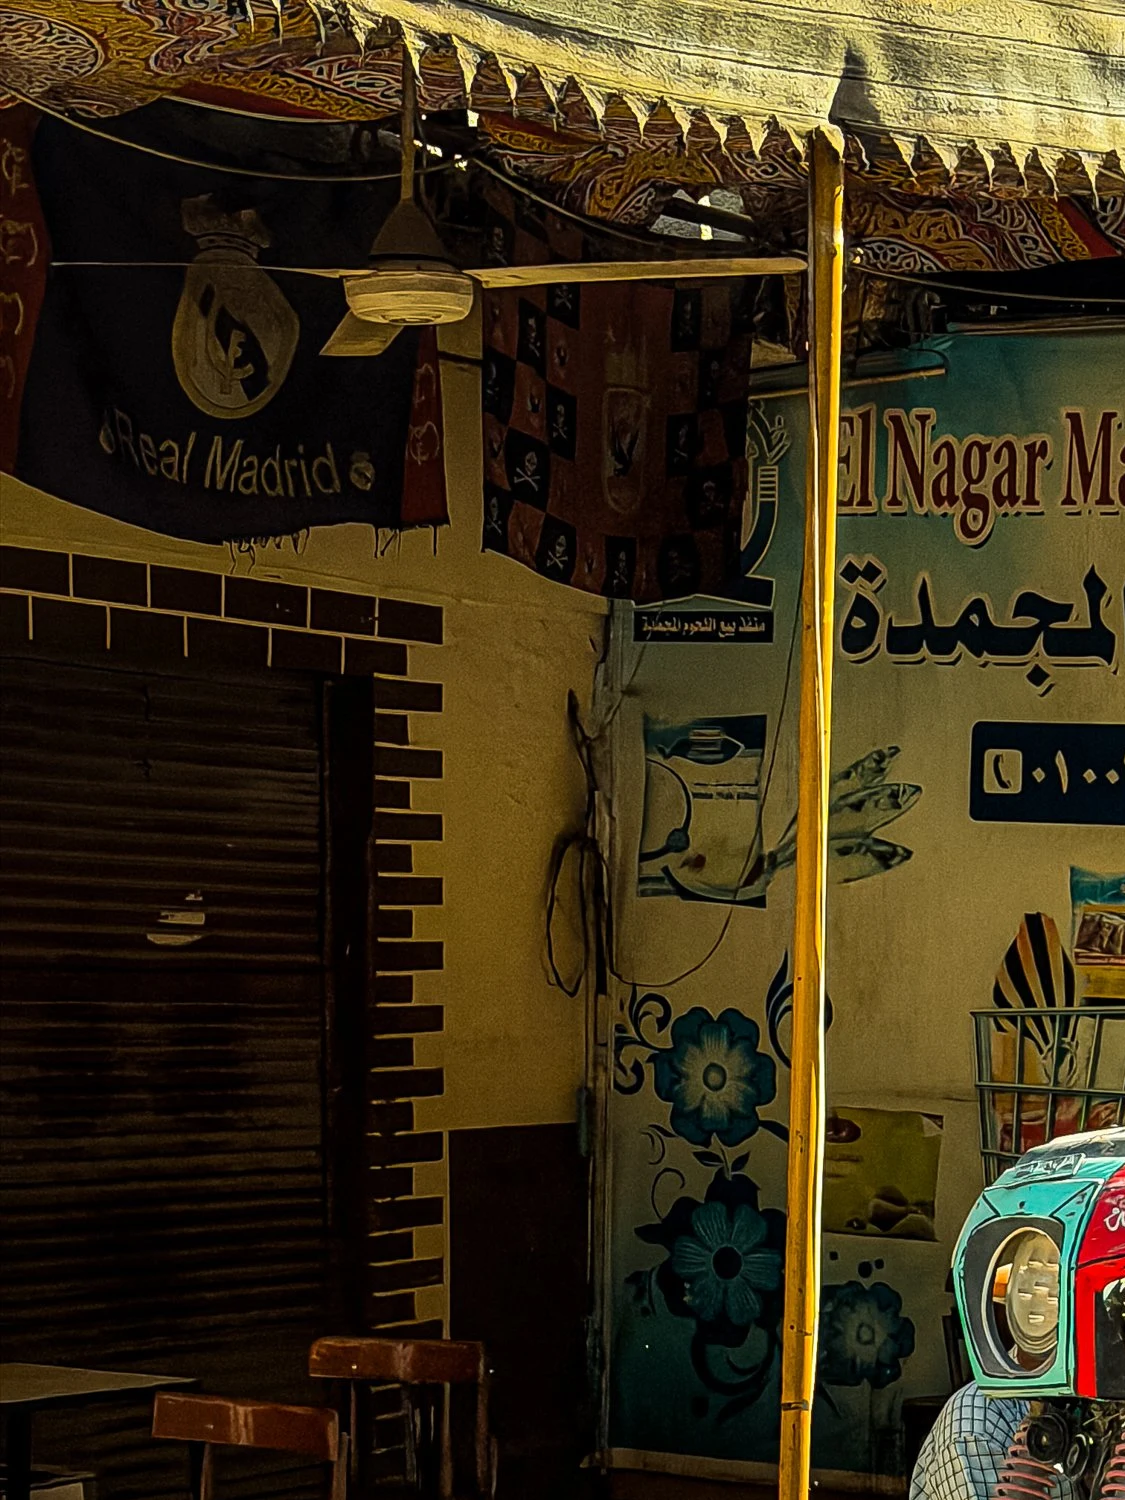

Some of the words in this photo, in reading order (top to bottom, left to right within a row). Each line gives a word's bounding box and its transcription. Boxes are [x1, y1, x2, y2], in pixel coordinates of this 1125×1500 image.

[114, 408, 197, 484] Real
[204, 435, 341, 497] Madrid
[886, 409, 1050, 541] Nagar
